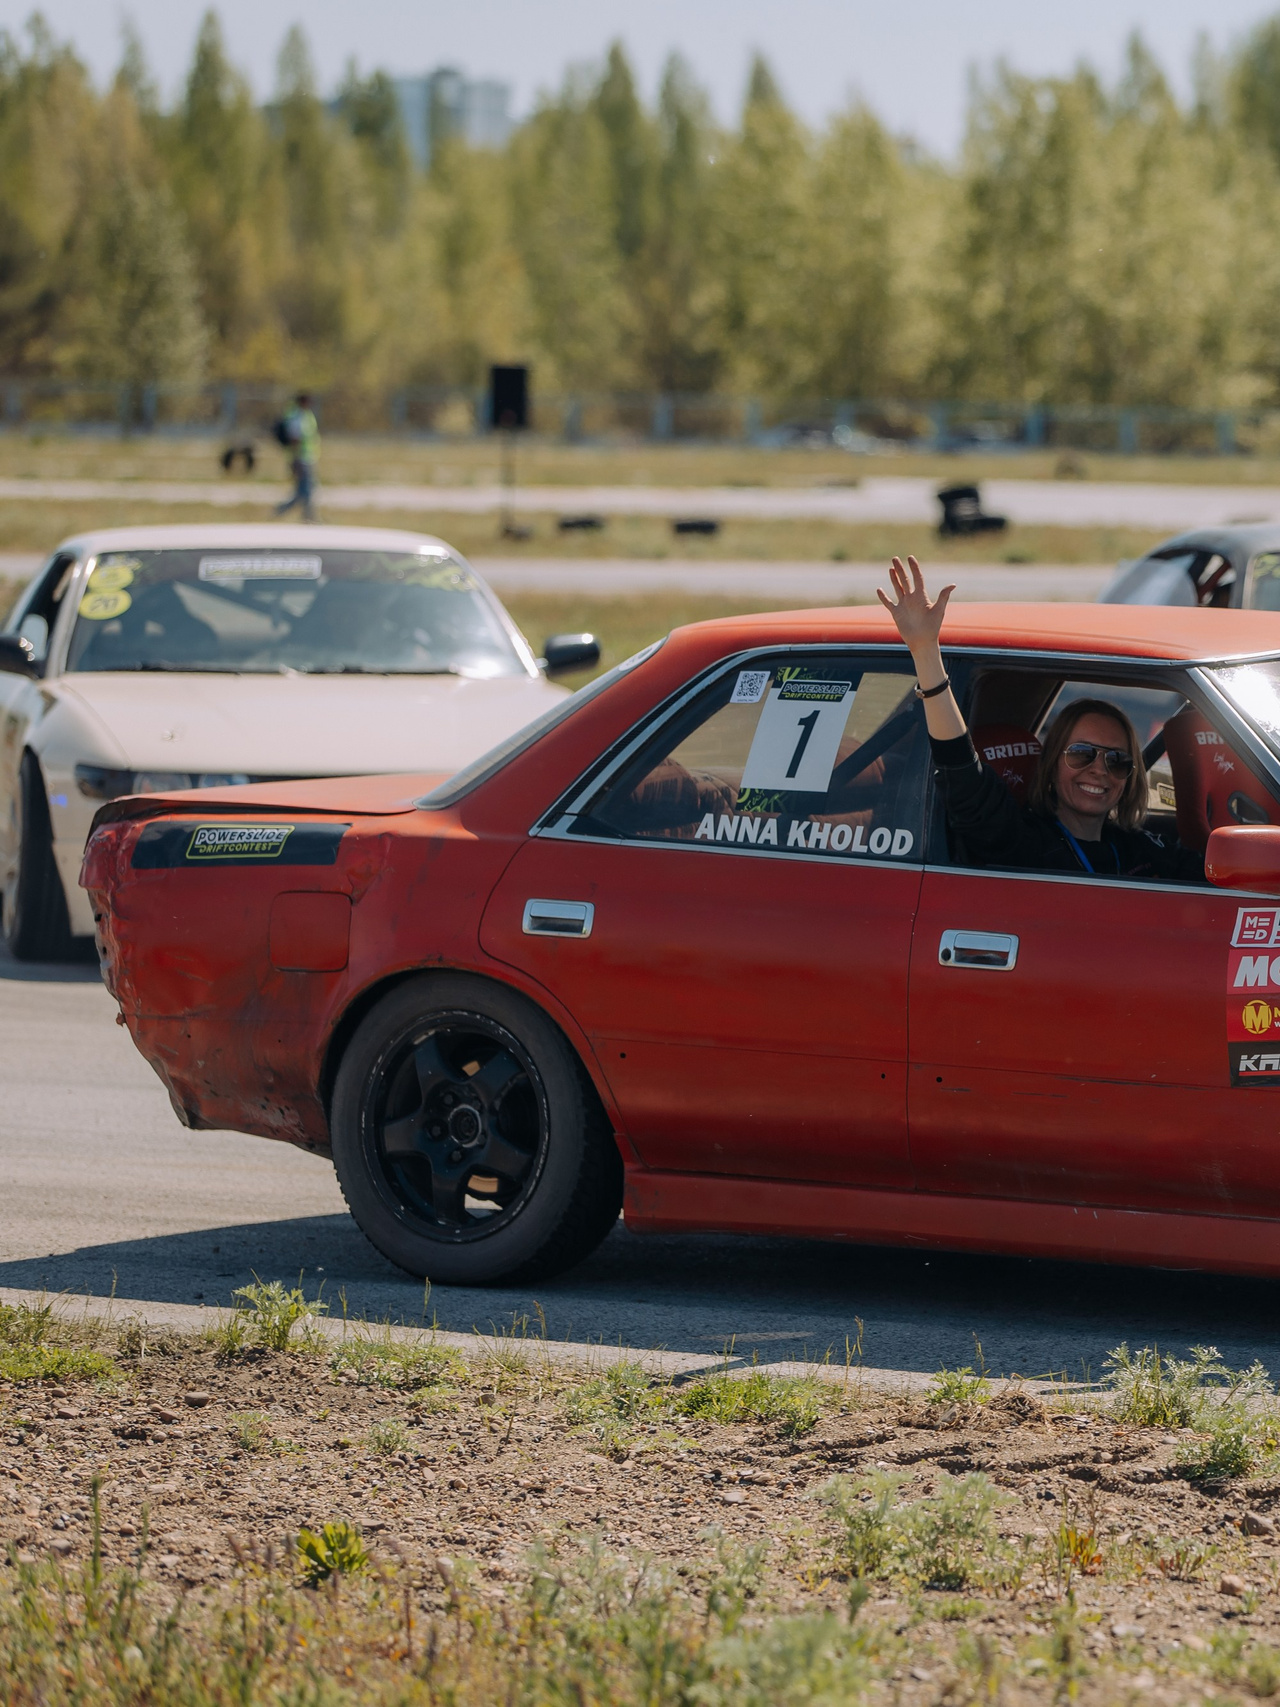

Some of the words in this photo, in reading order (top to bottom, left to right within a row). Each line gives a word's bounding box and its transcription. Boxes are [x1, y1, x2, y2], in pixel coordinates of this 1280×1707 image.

[782, 691, 843, 701] DRIFTCONTEST
[783, 682, 848, 695] POWERSLIDE
[785, 709, 821, 780] 1
[983, 742, 1041, 761] BRIDE
[195, 828, 290, 846] POWERSLIDE
[694, 812, 779, 846] ANNA
[786, 819, 915, 856] KHOLOD
[194, 842, 280, 853] DRIFTCONTEST
